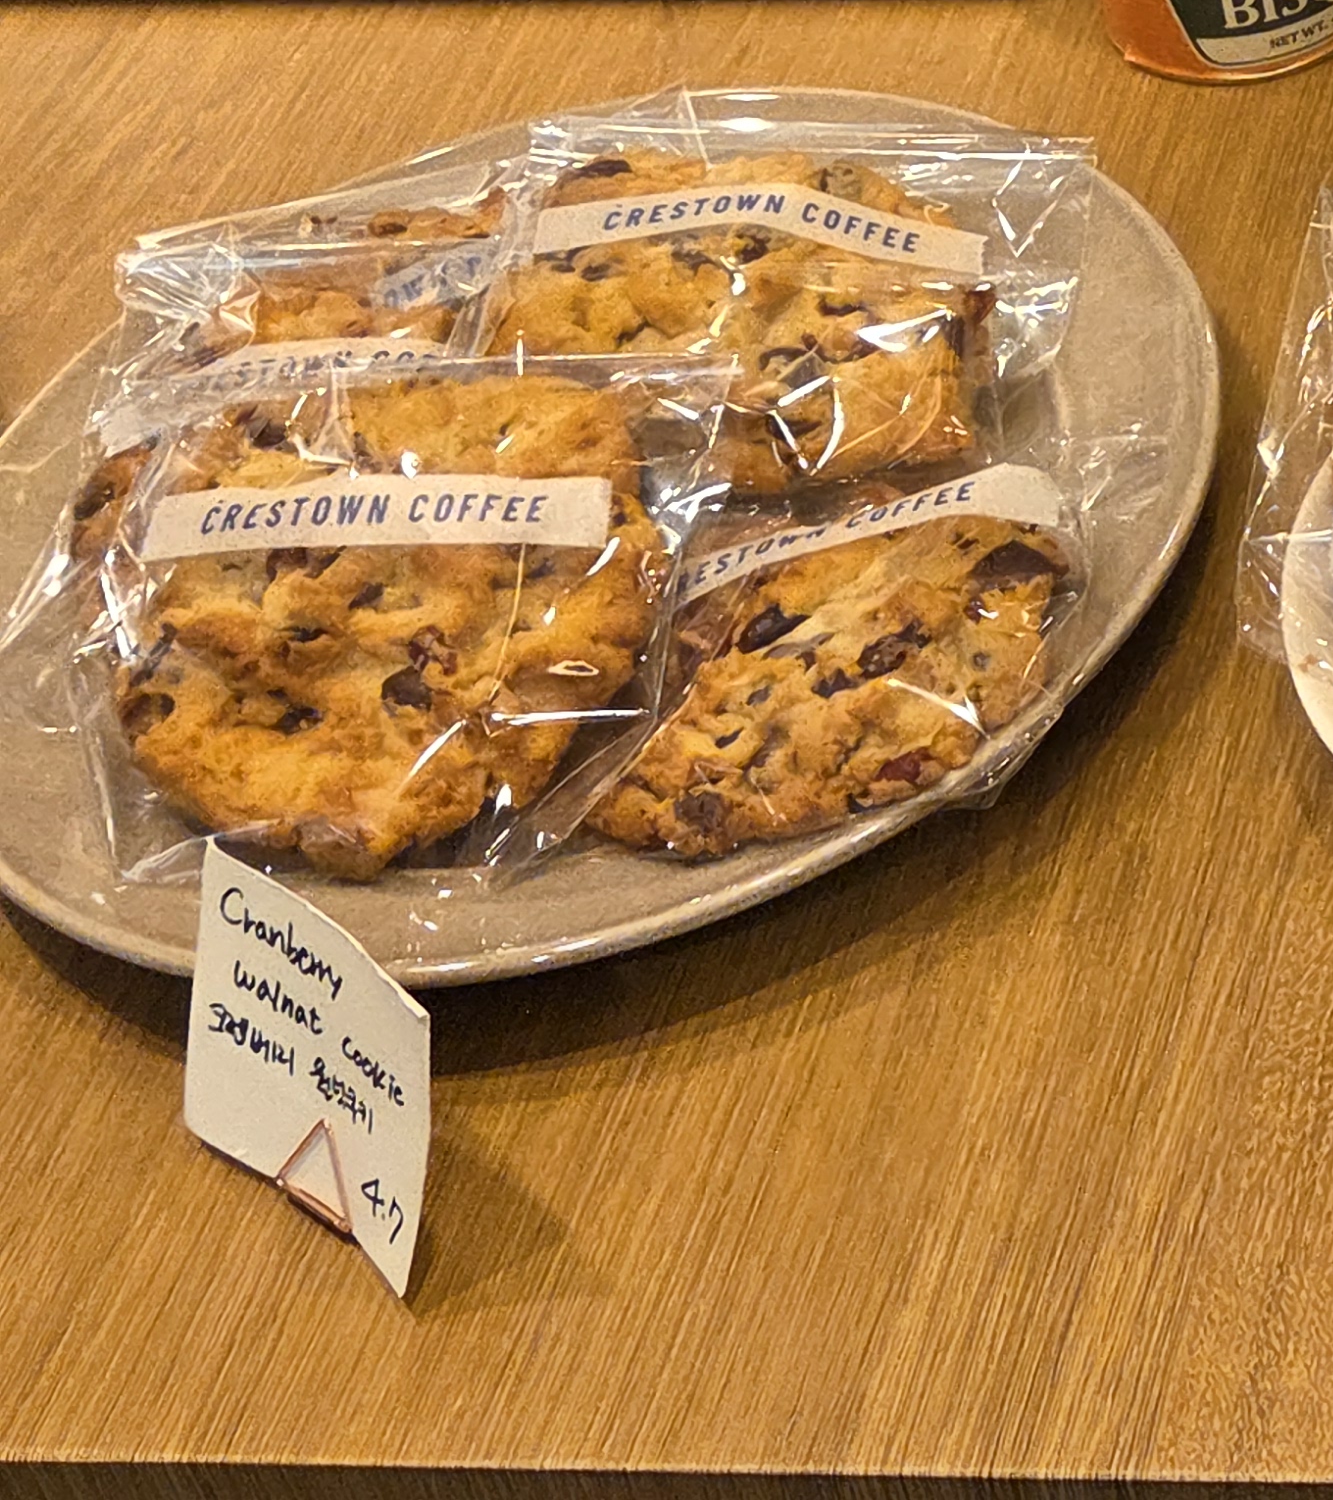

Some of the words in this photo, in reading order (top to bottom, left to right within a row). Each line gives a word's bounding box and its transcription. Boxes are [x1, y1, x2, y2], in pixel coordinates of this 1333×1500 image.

[1270, 30, 1299, 48] NET
[603, 194, 785, 231] CRESTOWN
[801, 203, 920, 253] COFFEE
[200, 494, 390, 535] CRESTOWN
[408, 494, 550, 523] COFFEE
[845, 481, 975, 529] COFFEE
[220, 887, 343, 1000] Cranberry
[361, 1178, 405, 1244] 4.7
